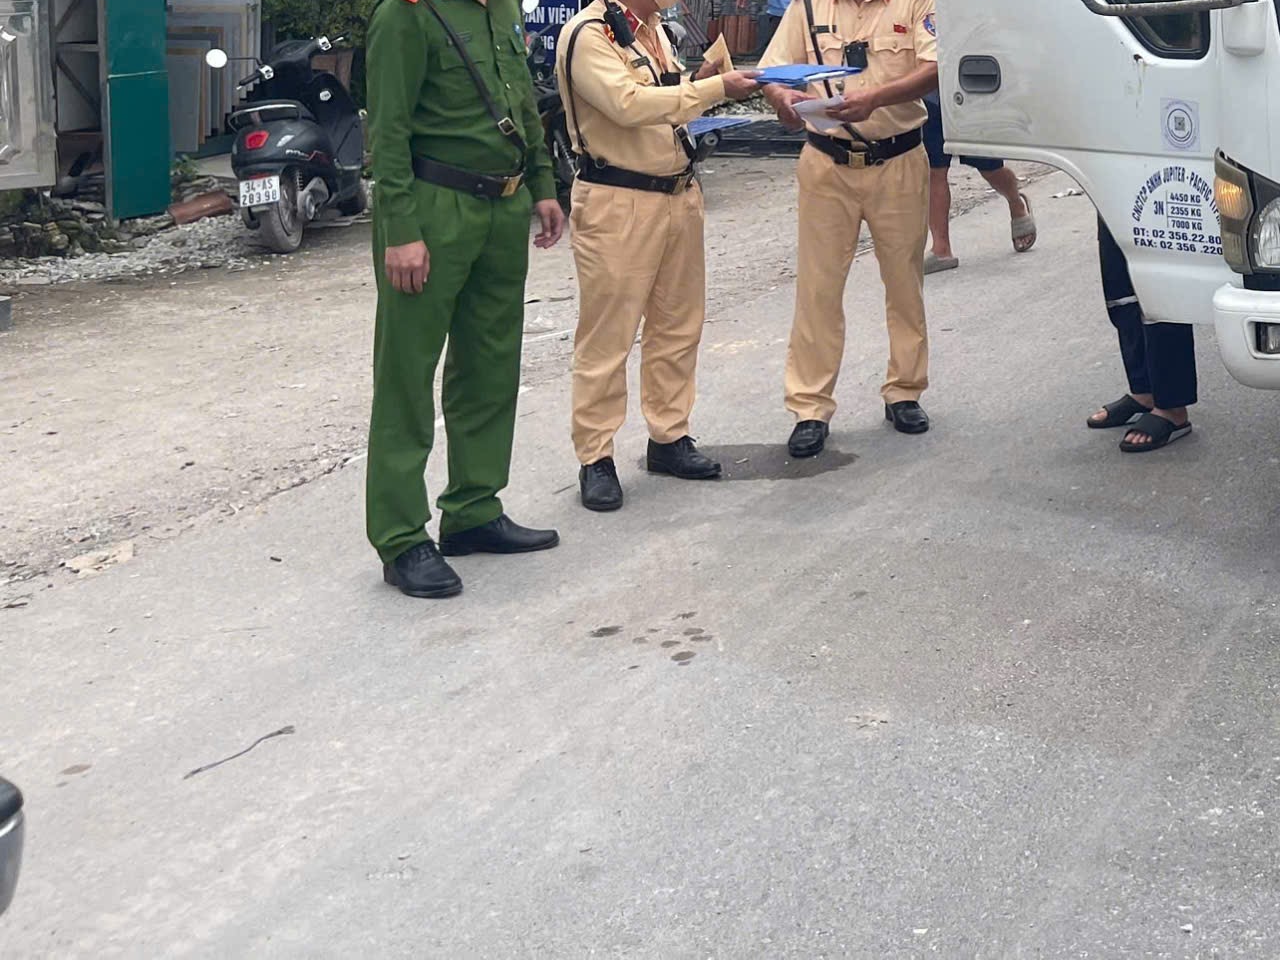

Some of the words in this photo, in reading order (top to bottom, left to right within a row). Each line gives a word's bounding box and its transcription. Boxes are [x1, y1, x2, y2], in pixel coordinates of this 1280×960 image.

[1190, 194, 1201, 203] KG
[1190, 208, 1202, 217] KG
[1134, 237, 1157, 248] FAX:
